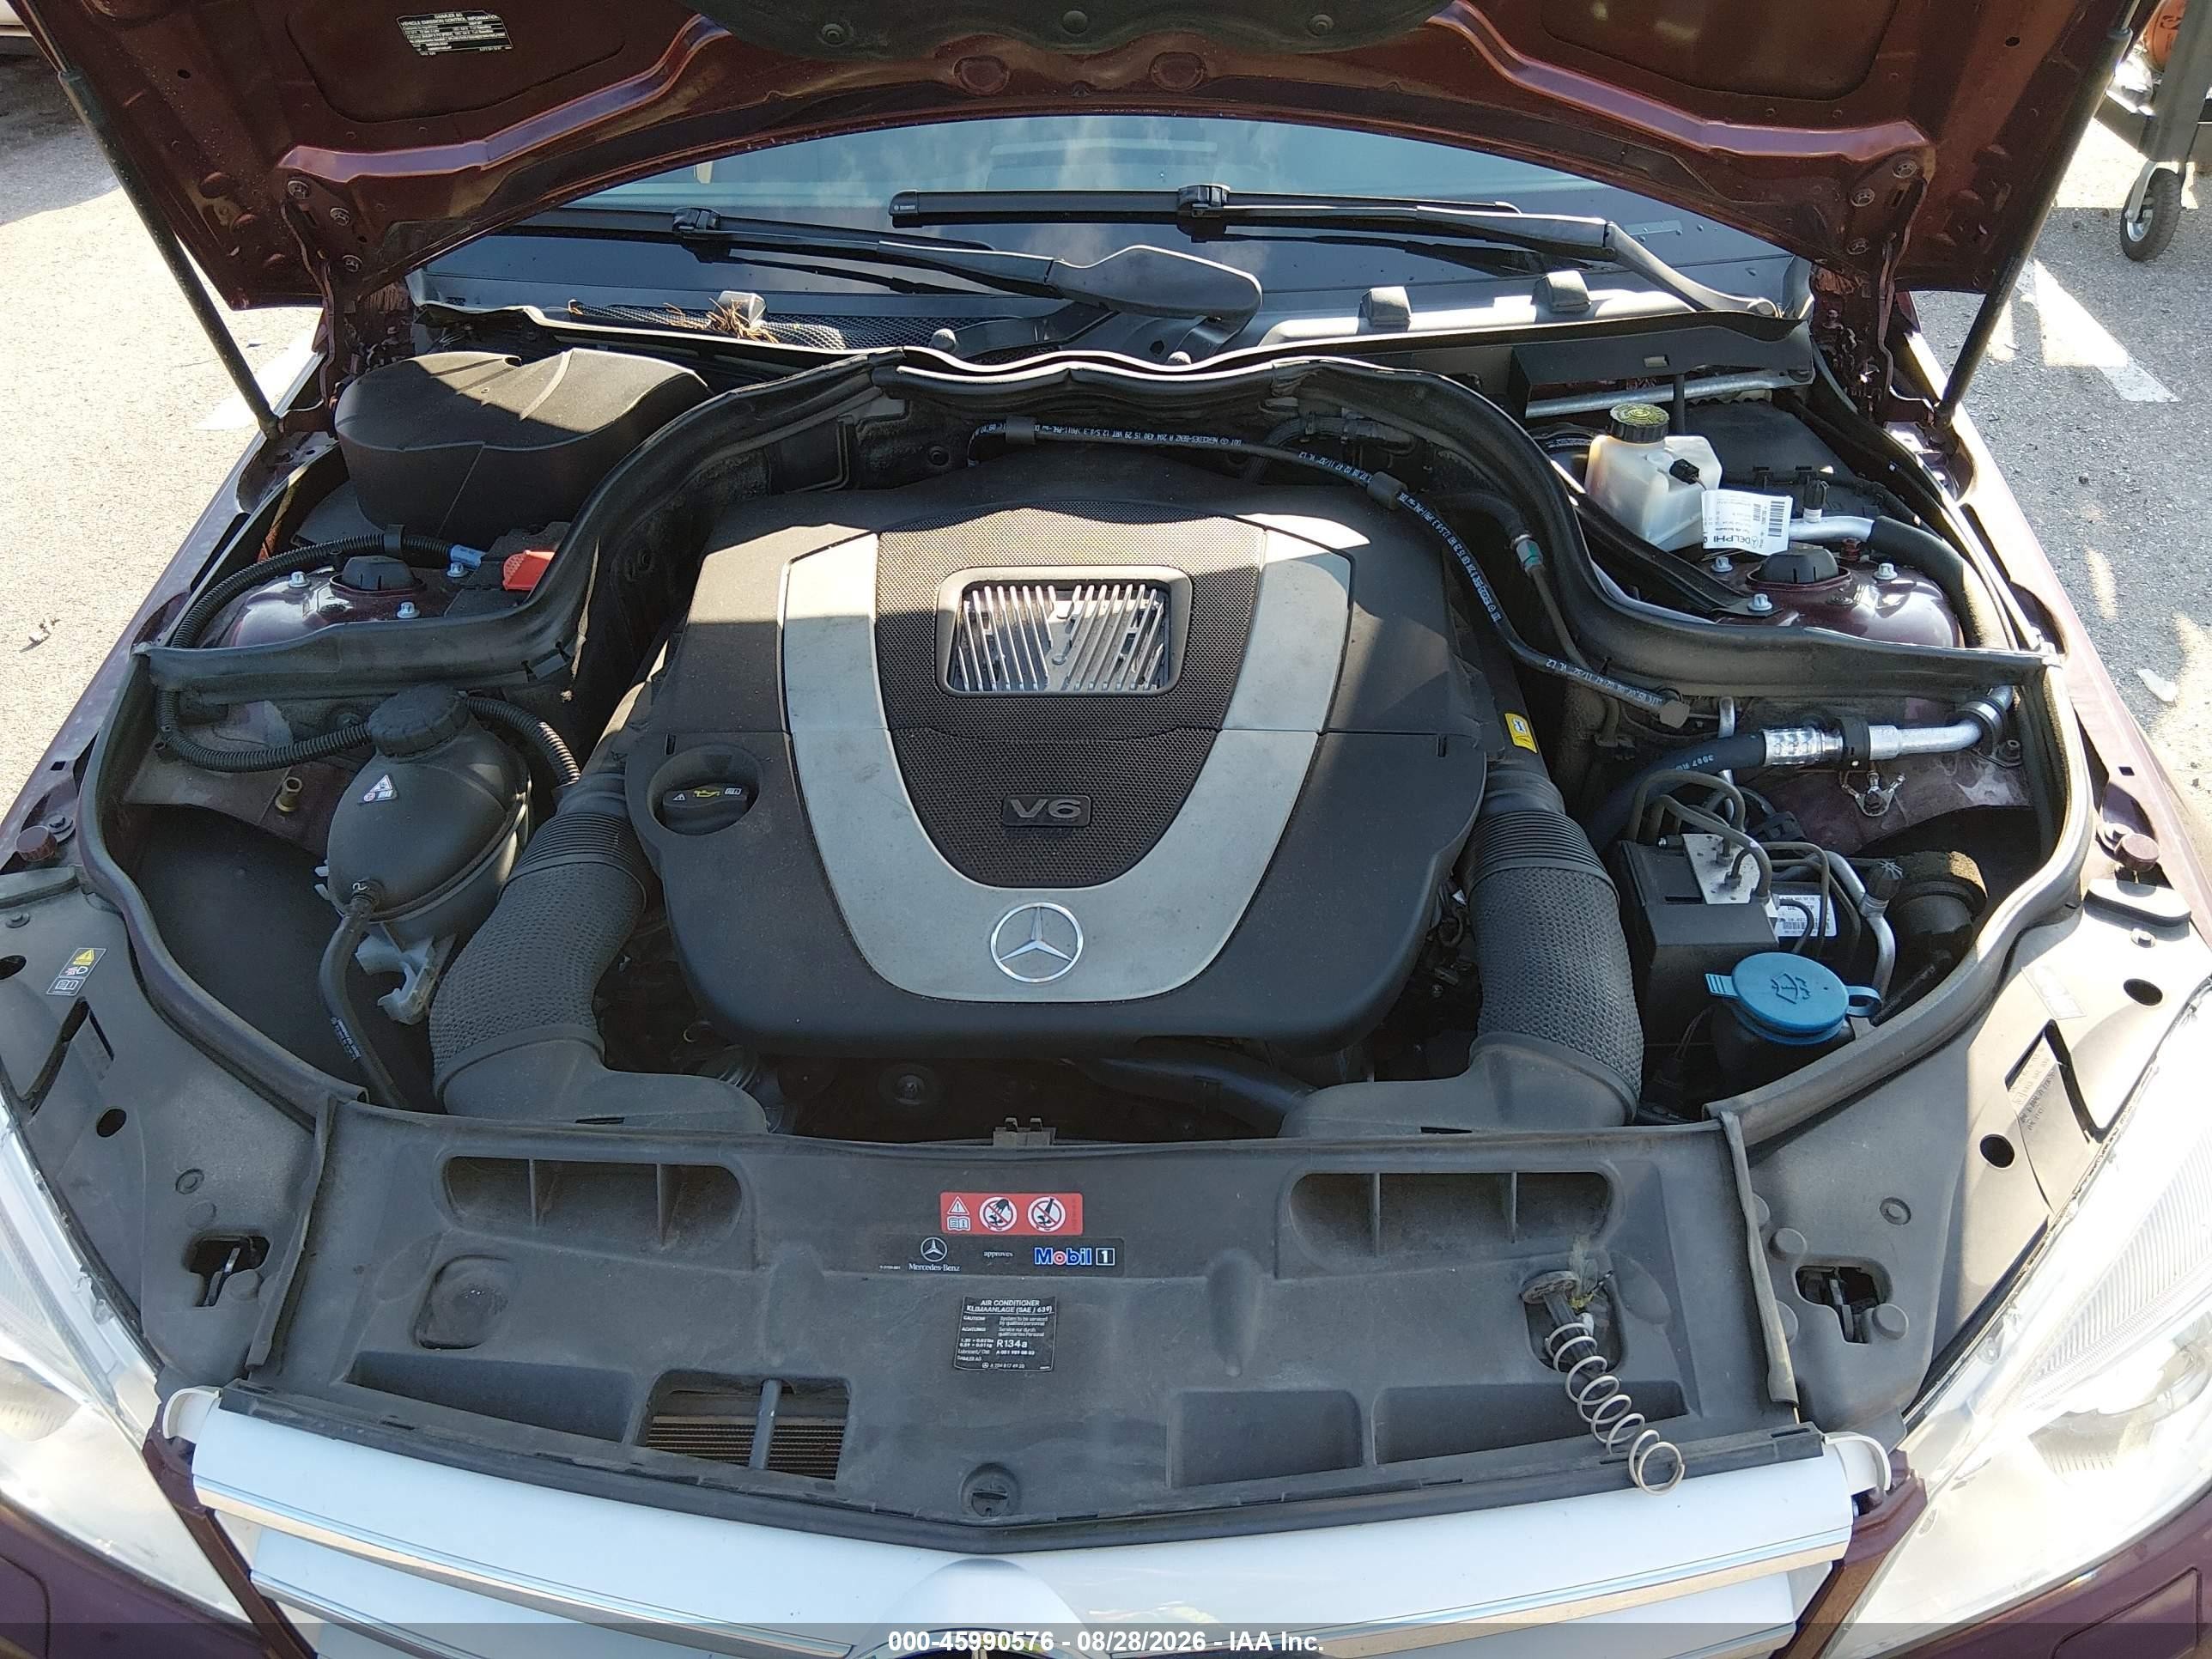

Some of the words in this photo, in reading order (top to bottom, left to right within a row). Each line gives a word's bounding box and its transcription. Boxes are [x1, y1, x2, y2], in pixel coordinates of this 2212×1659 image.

[1713, 535, 1751, 545] DELPHI
[1011, 799, 1080, 817] V6
[1034, 1247, 1092, 1266] Mobil
[908, 1262, 961, 1272] Mercedes-Benz
[996, 1339, 1028, 1348] R134a
